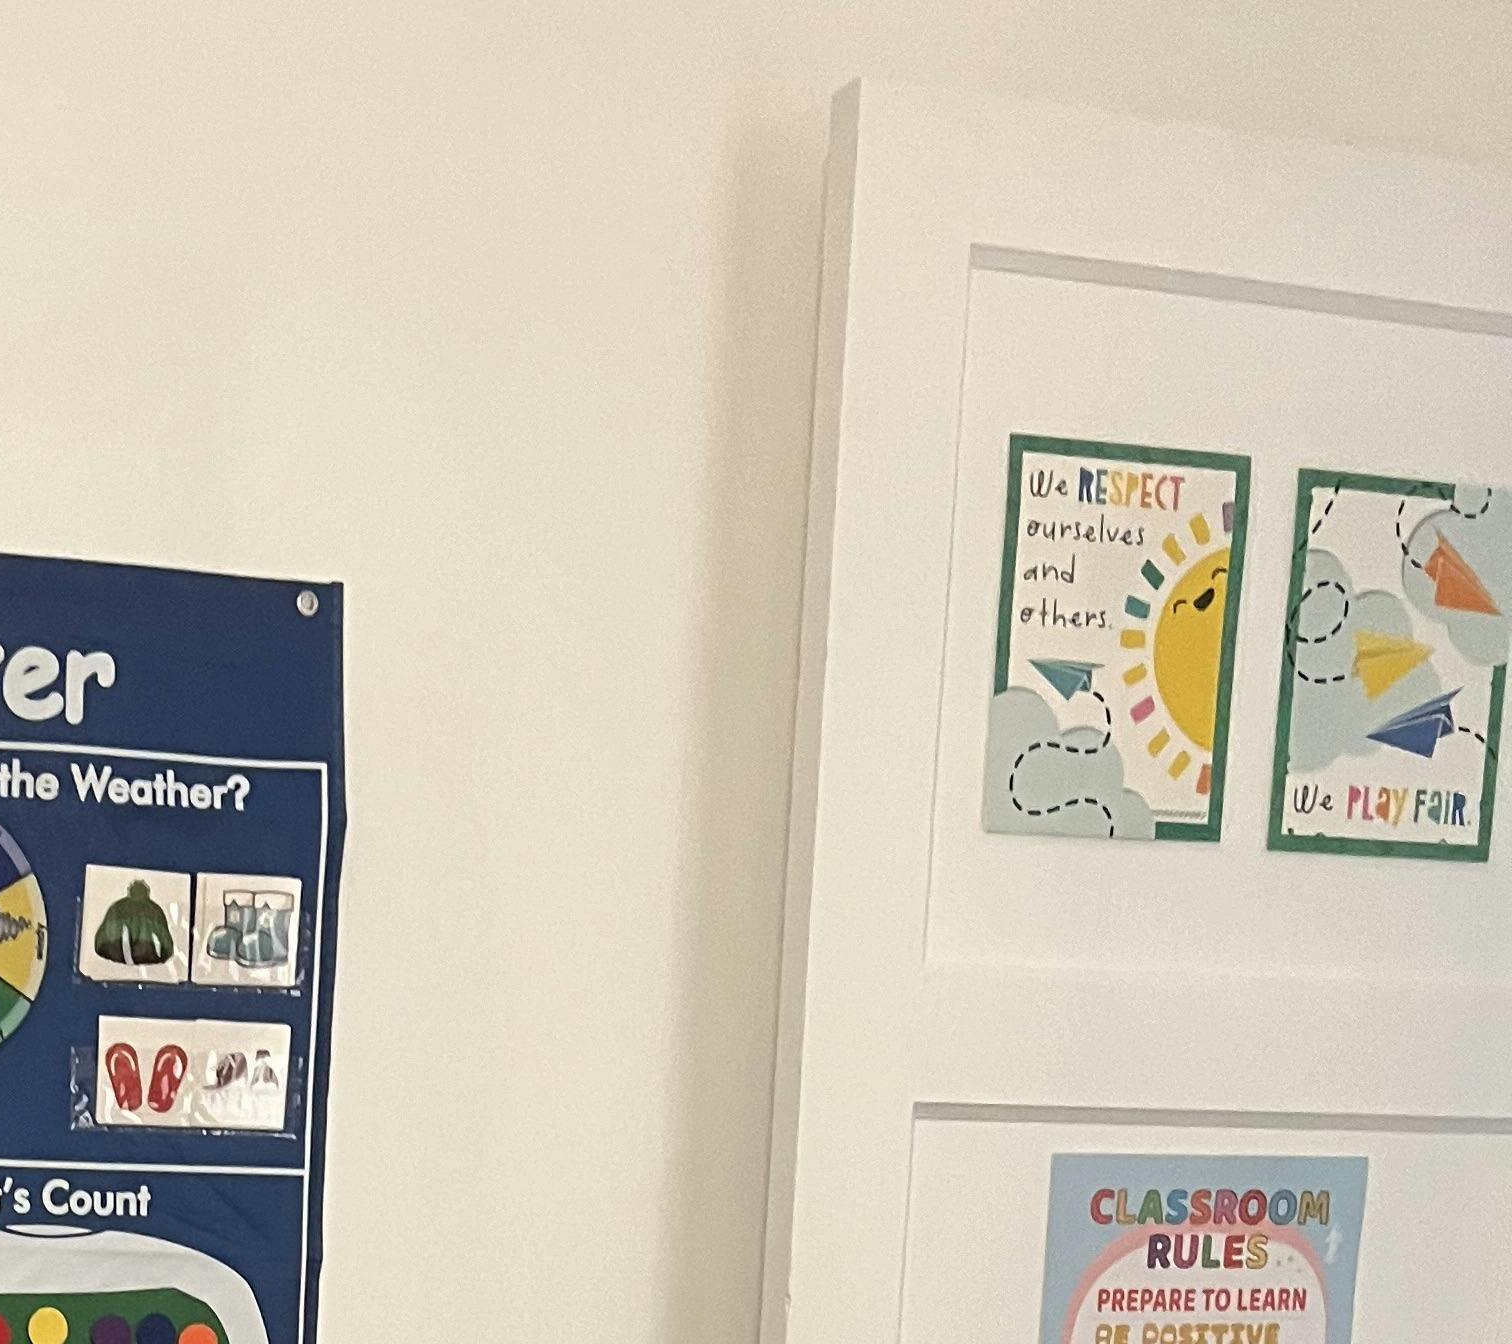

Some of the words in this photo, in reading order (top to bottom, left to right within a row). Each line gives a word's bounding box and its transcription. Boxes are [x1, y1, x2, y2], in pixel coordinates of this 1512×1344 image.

[1029, 470, 1069, 498] We
[1077, 467, 1186, 512] RESPECT
[1026, 515, 1145, 546] ourselves
[1023, 554, 1077, 585] and
[1019, 597, 1114, 631] others.
[71, 762, 250, 811] Weather?
[1293, 784, 1334, 814] We
[41, 1178, 152, 1218] Count
[1090, 1188, 1330, 1225] CLASSROOM
[1146, 1233, 1269, 1270] RULES
[1097, 1288, 1196, 1312] PREPARE
[1202, 1288, 1231, 1311] TO
[1236, 1288, 1307, 1311] LEARN
